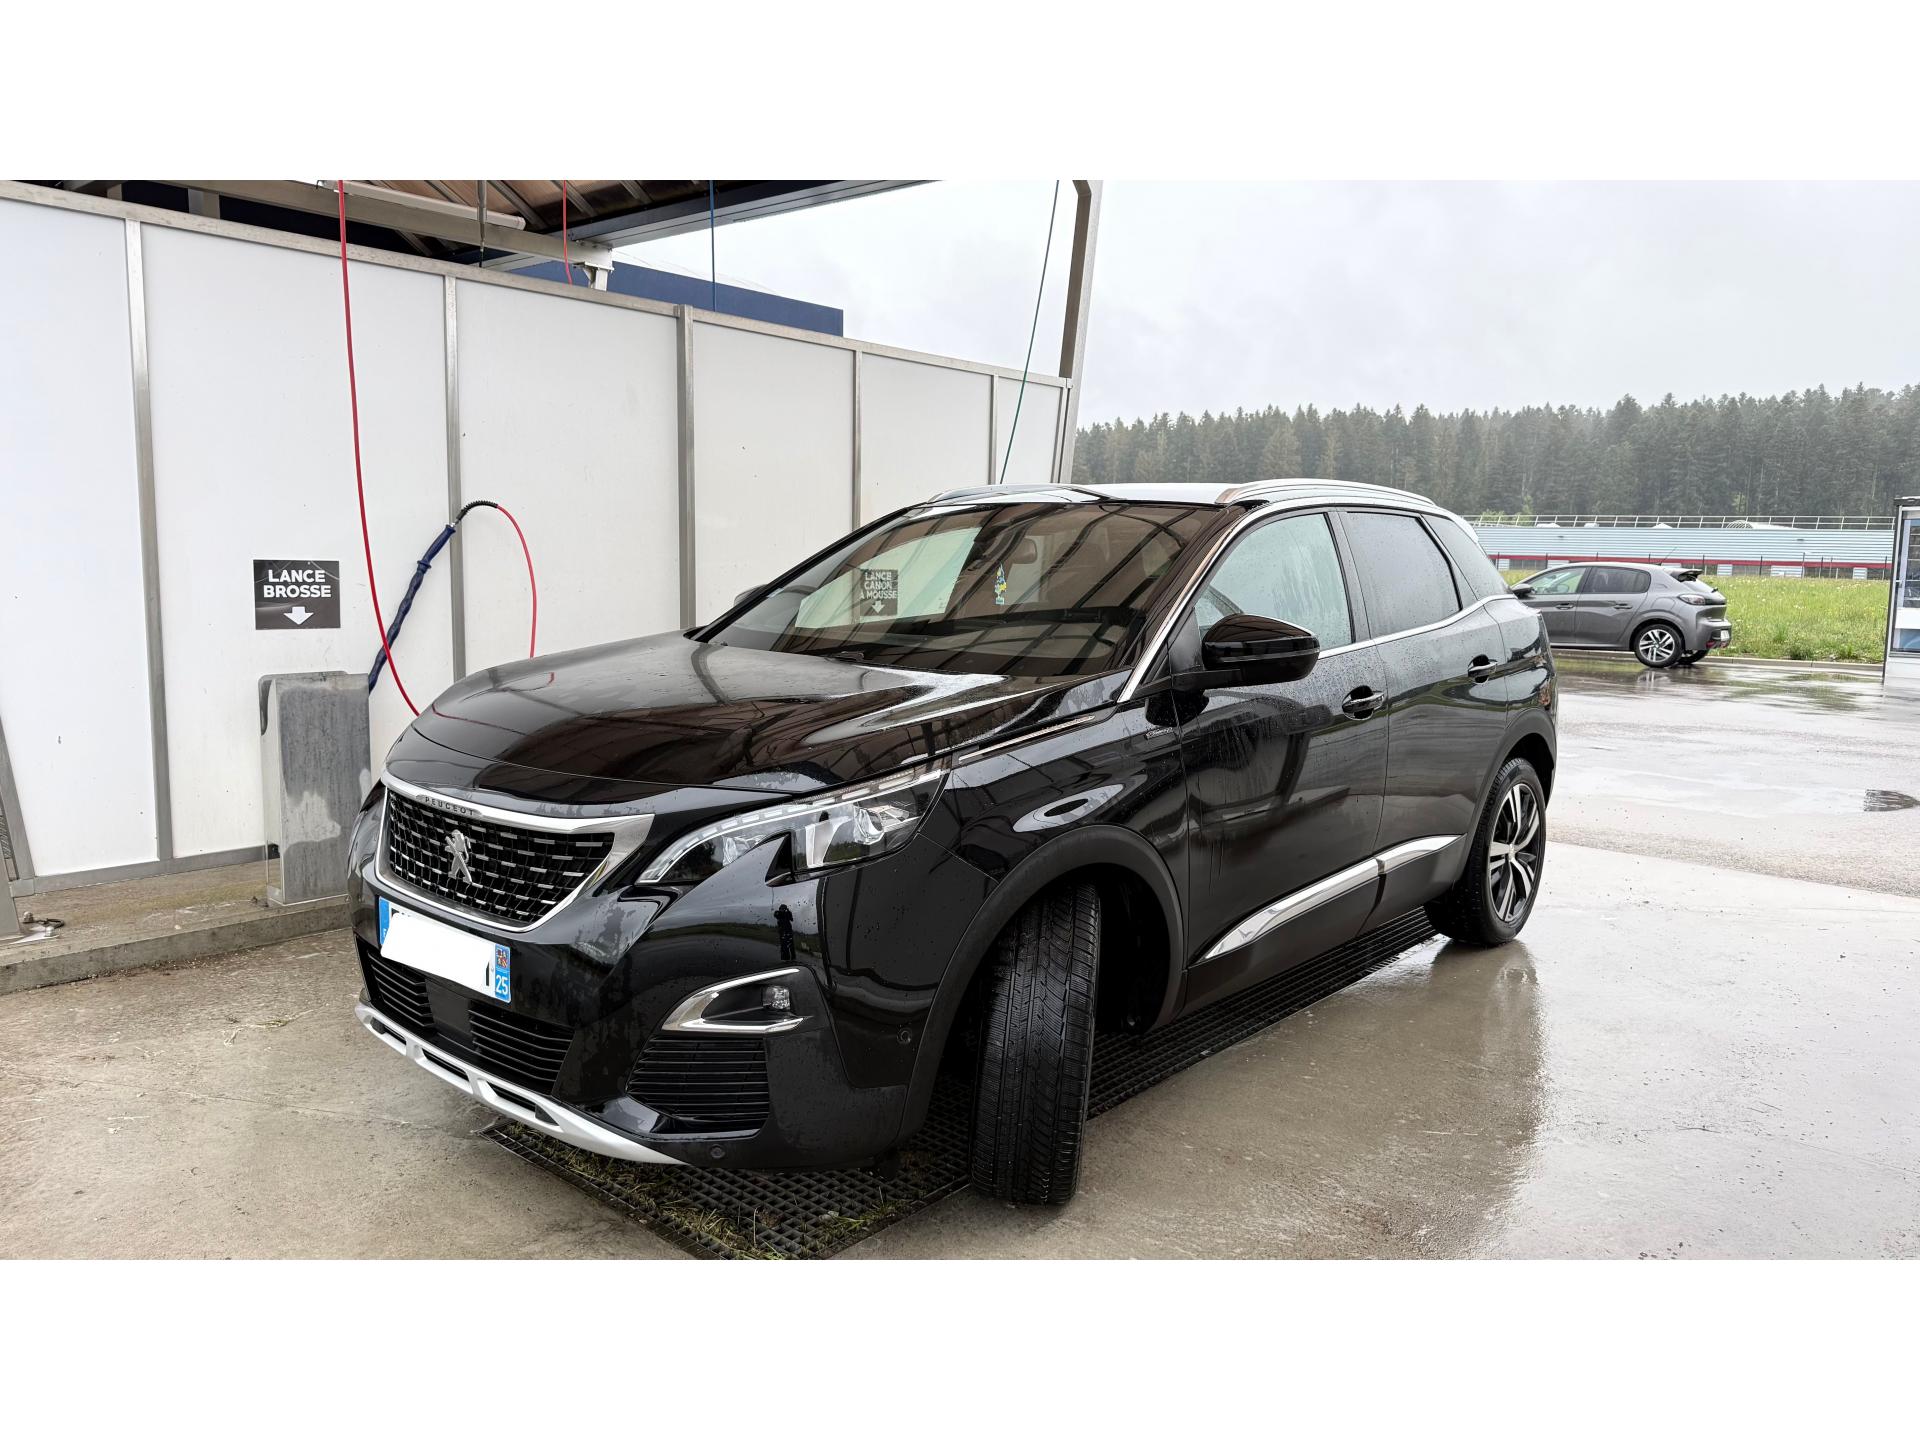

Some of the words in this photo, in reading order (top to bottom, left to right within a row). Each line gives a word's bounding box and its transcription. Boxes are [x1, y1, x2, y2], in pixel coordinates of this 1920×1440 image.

[268, 569, 326, 583] LANCE
[865, 571, 892, 581] LANCE
[263, 584, 332, 598] BROSSE
[864, 580, 893, 590] CANON
[866, 590, 898, 599] MOUSSE
[425, 796, 474, 816] PEUGEOT
[495, 974, 509, 996] 25
